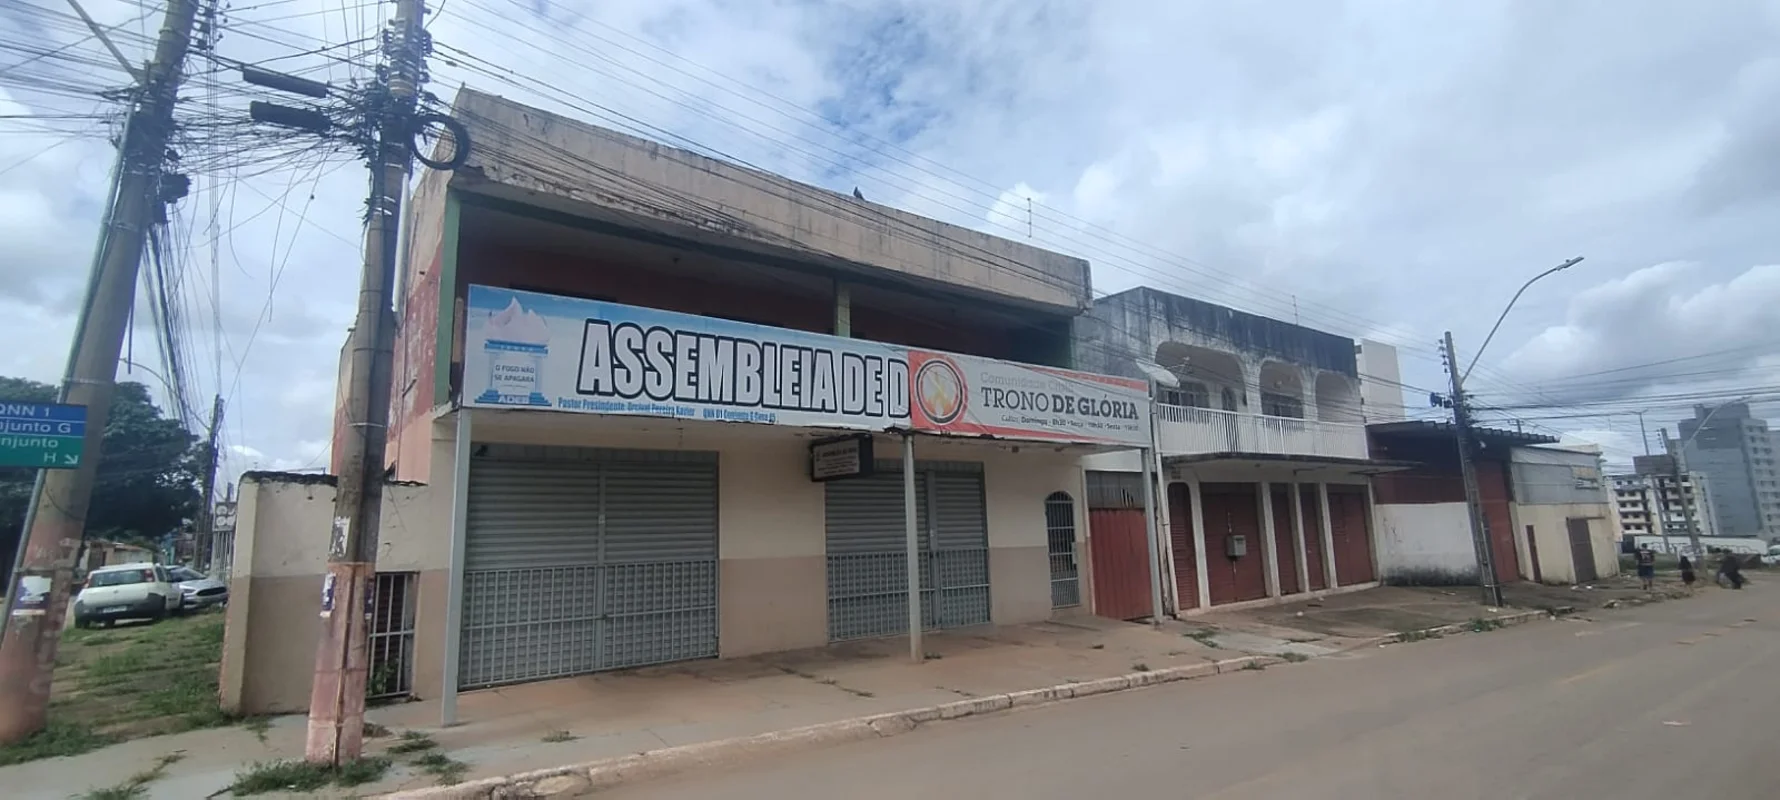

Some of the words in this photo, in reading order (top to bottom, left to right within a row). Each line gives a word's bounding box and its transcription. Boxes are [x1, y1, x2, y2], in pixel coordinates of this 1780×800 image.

[576, 318, 837, 413] ASSEMBLEIA
[841, 352, 883, 416] DE
[981, 386, 1049, 412] TRONO
[1051, 394, 1075, 415] DE
[1077, 393, 1139, 420] GLÓRIA
[44, 406, 50, 417] 1
[58, 422, 71, 434] G
[43, 452, 57, 463] H
